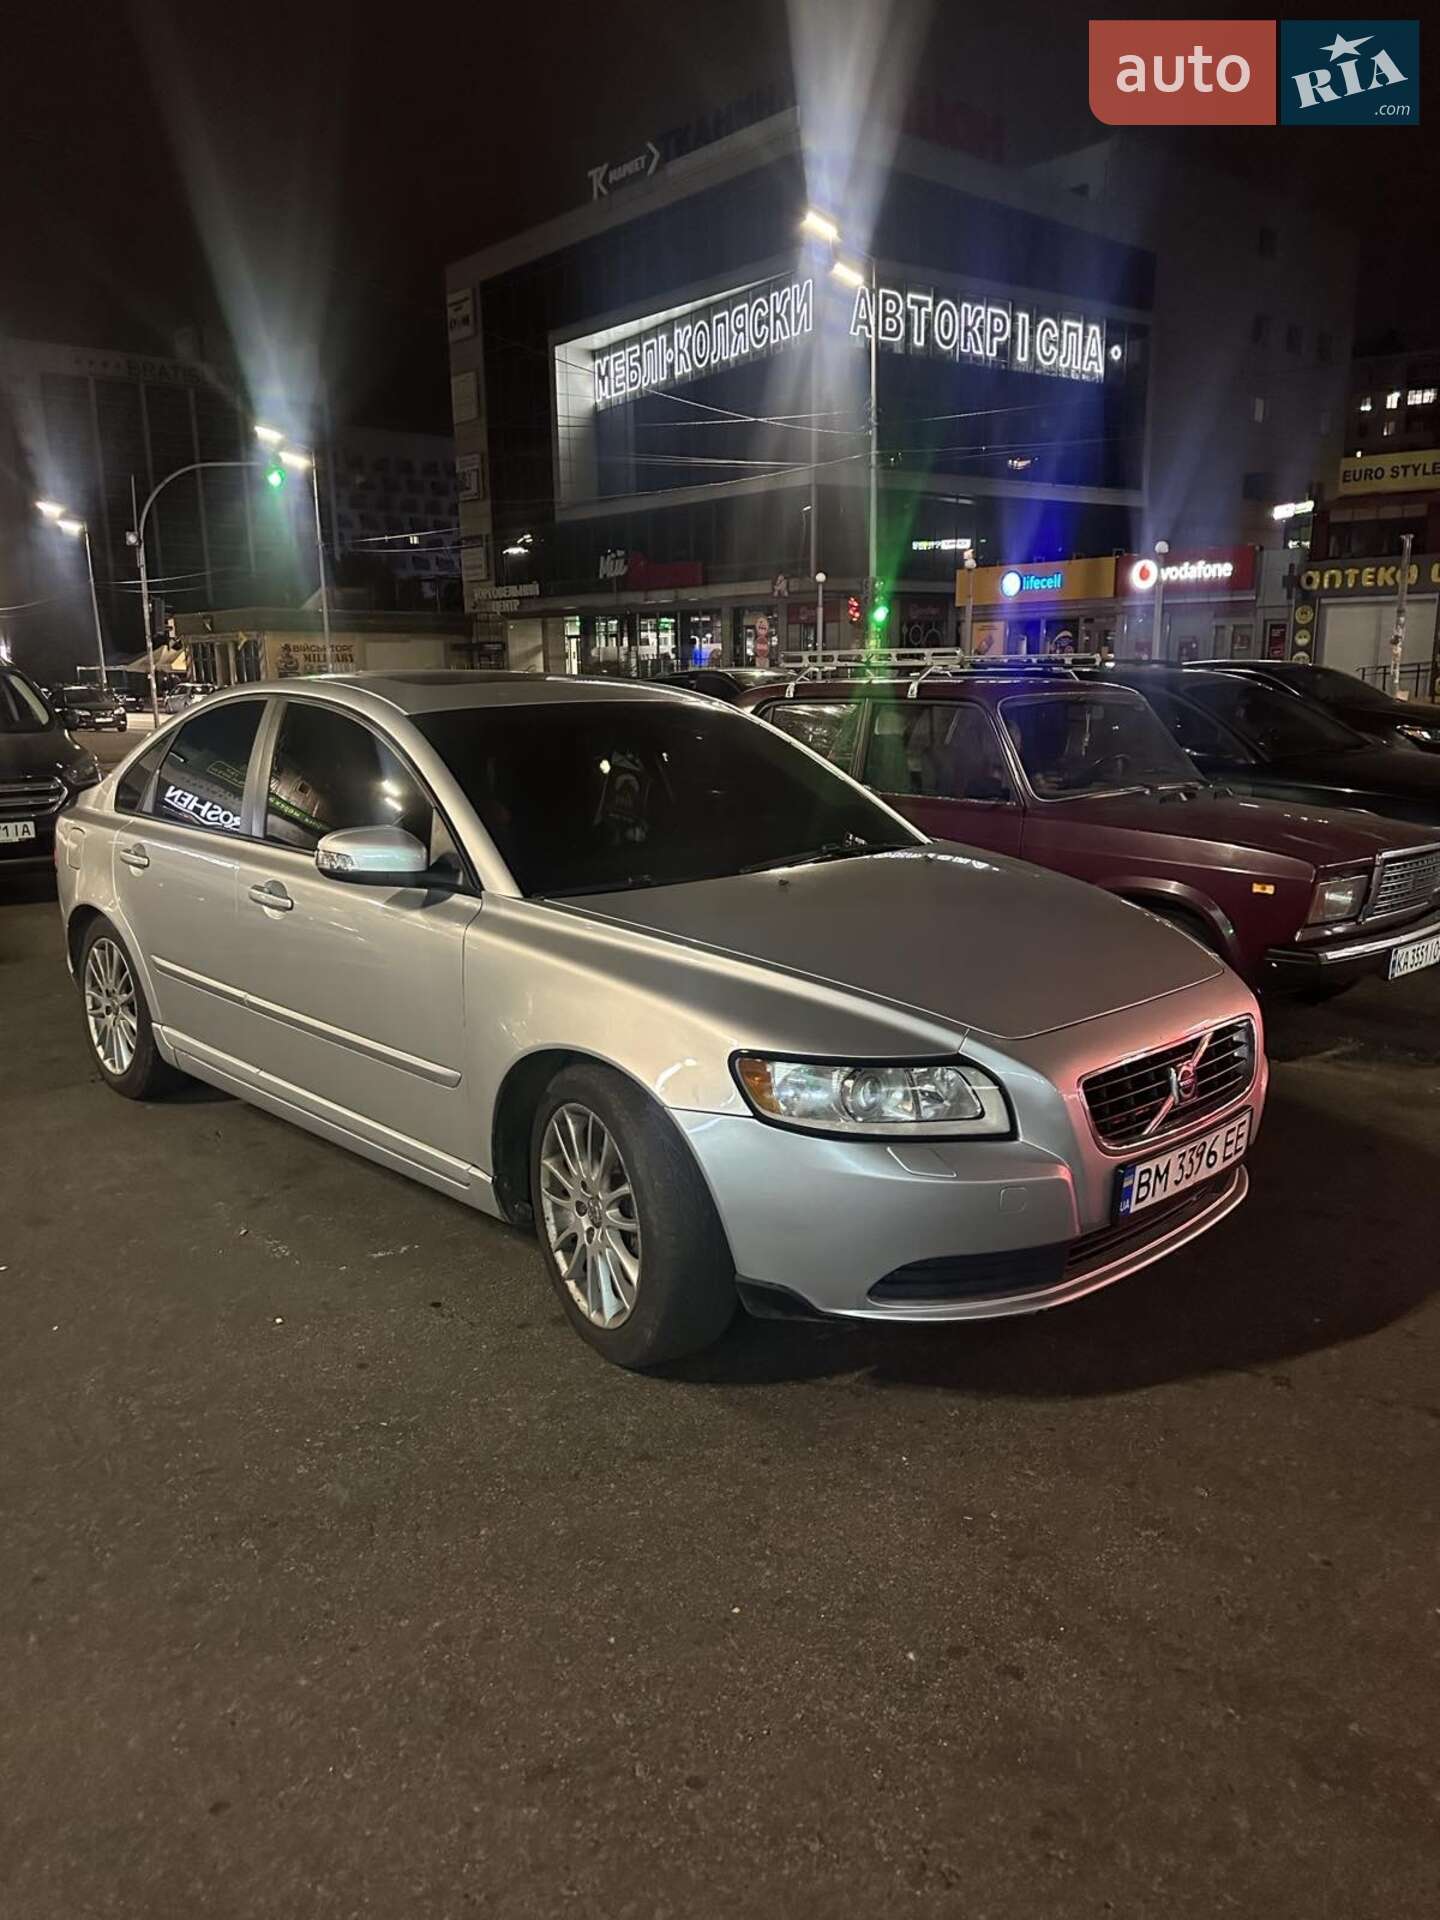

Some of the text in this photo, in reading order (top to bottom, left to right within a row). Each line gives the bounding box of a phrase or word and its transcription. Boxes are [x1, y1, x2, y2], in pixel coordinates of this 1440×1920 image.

[1342, 461, 1440, 483] EURO STYLE
[1022, 572, 1062, 591] lifecell
[1160, 559, 1233, 582] vodafone
[1135, 1158, 1171, 1205] BM
[1223, 1120, 1246, 1163] EE
